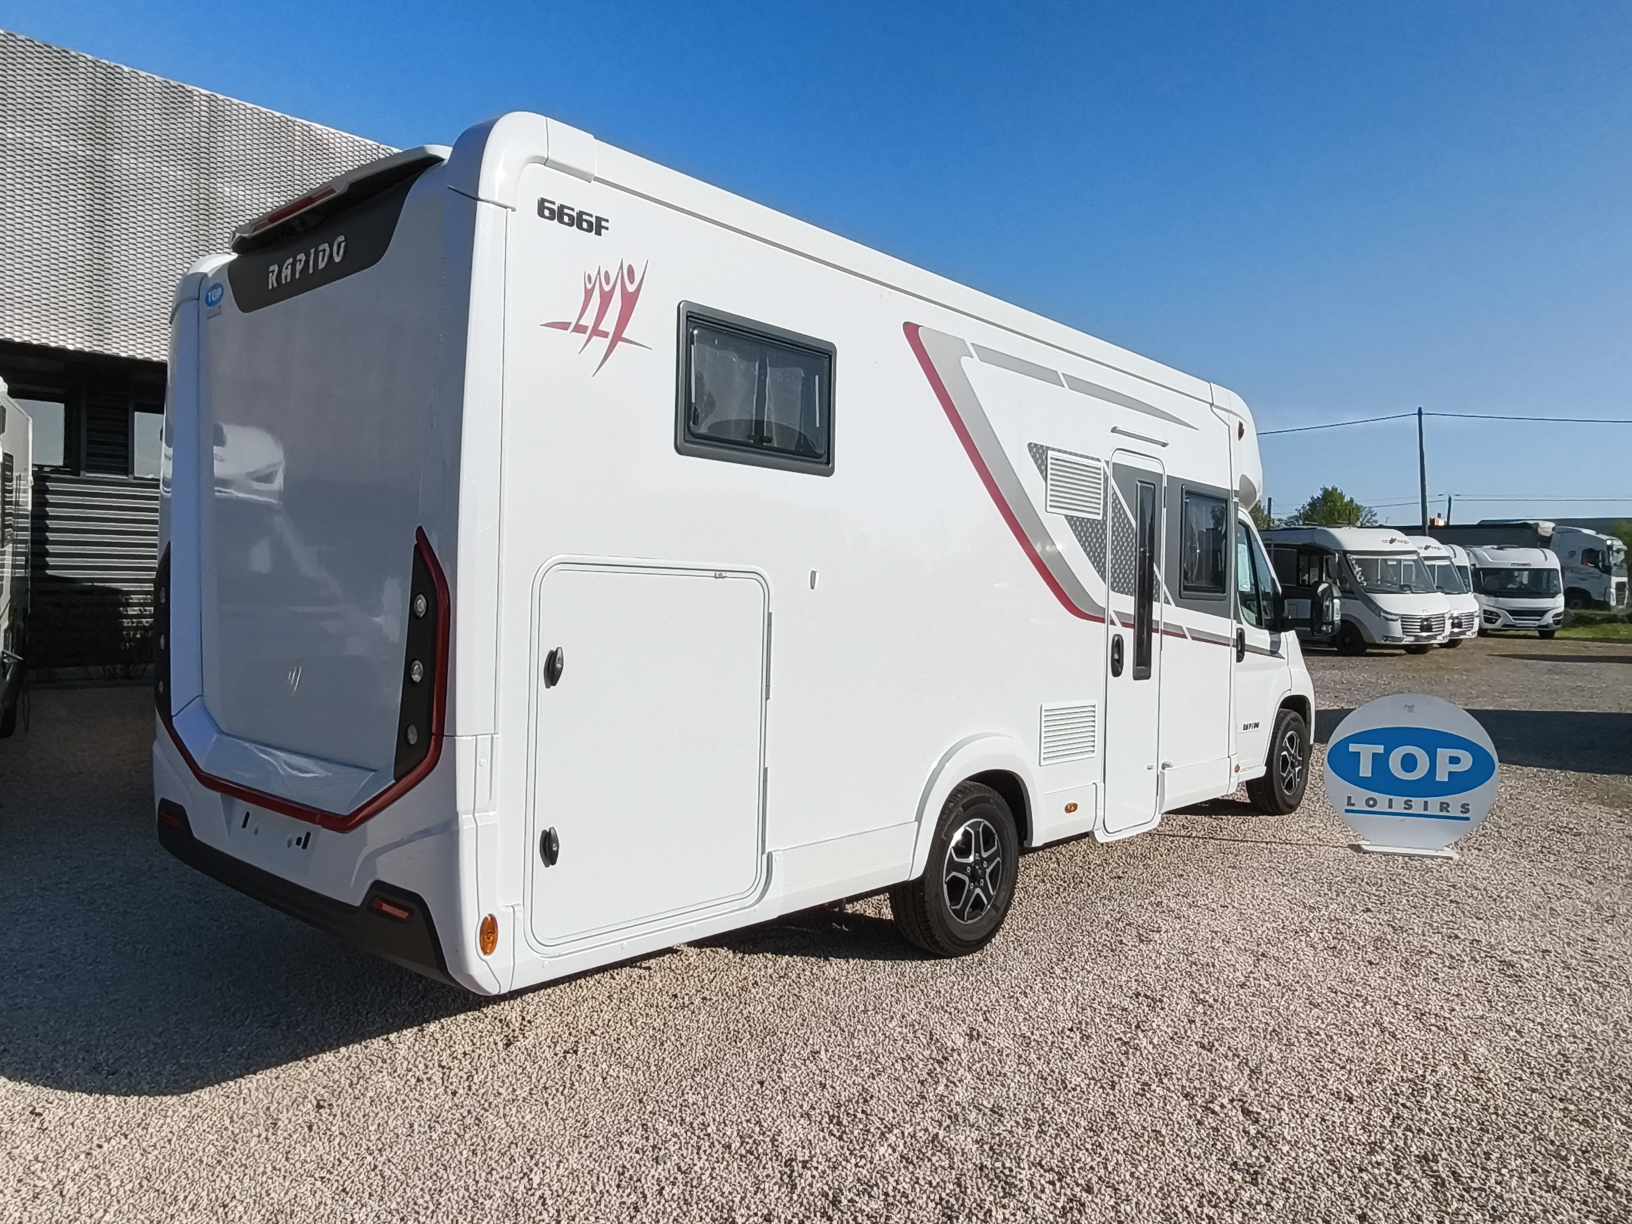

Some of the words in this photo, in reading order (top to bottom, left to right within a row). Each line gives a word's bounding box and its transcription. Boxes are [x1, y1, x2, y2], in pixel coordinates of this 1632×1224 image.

[537, 197, 609, 236] 666F
[267, 235, 346, 290] RAPIDO
[1348, 743, 1473, 782] TOP
[1346, 796, 1471, 815] LOISIRS
